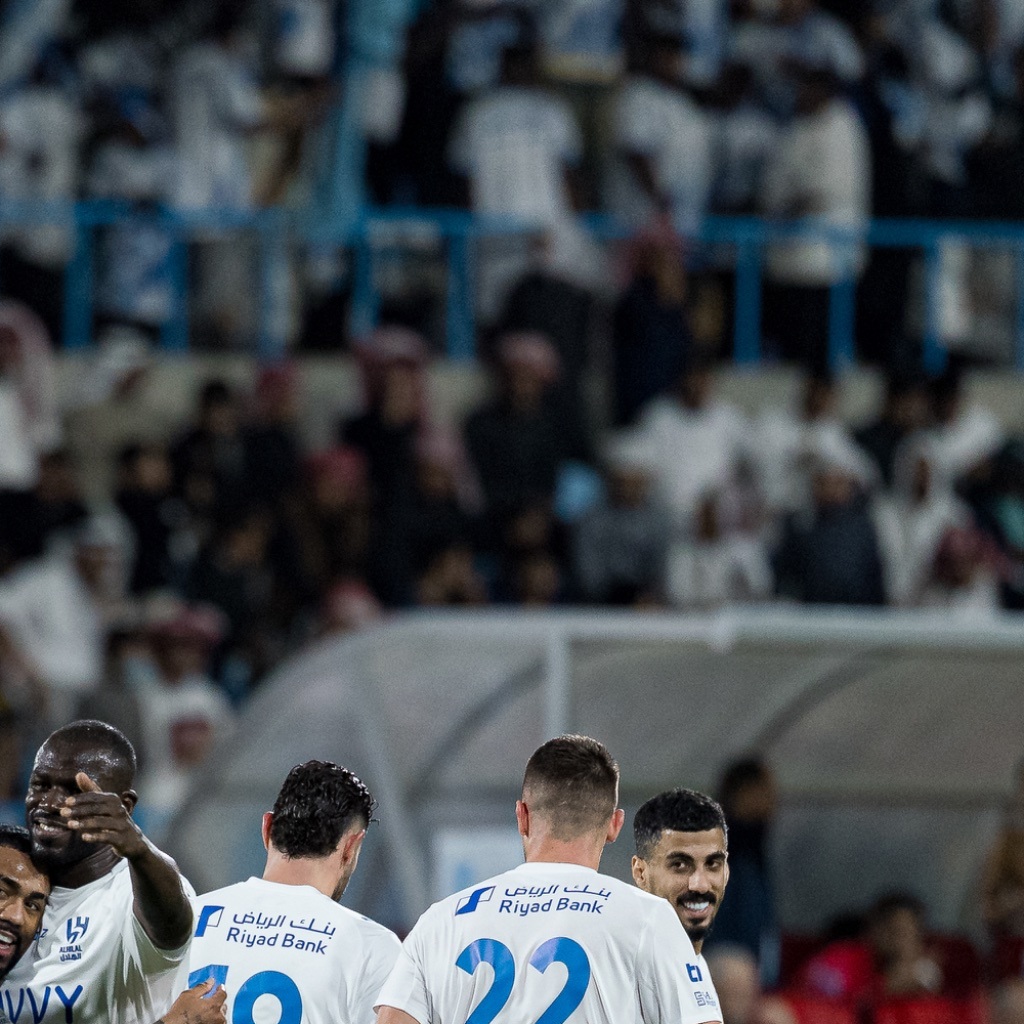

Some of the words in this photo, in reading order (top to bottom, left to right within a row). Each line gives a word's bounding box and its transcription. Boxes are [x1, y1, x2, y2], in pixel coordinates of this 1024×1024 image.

[504, 885, 559, 898] الرياض
[564, 885, 612, 901] بنك
[499, 899, 553, 917] Riyad
[556, 898, 604, 914] Bank
[232, 911, 287, 929] الرياض
[289, 918, 336, 940] بنك
[226, 927, 279, 948] Riyad
[281, 933, 328, 955] Bank
